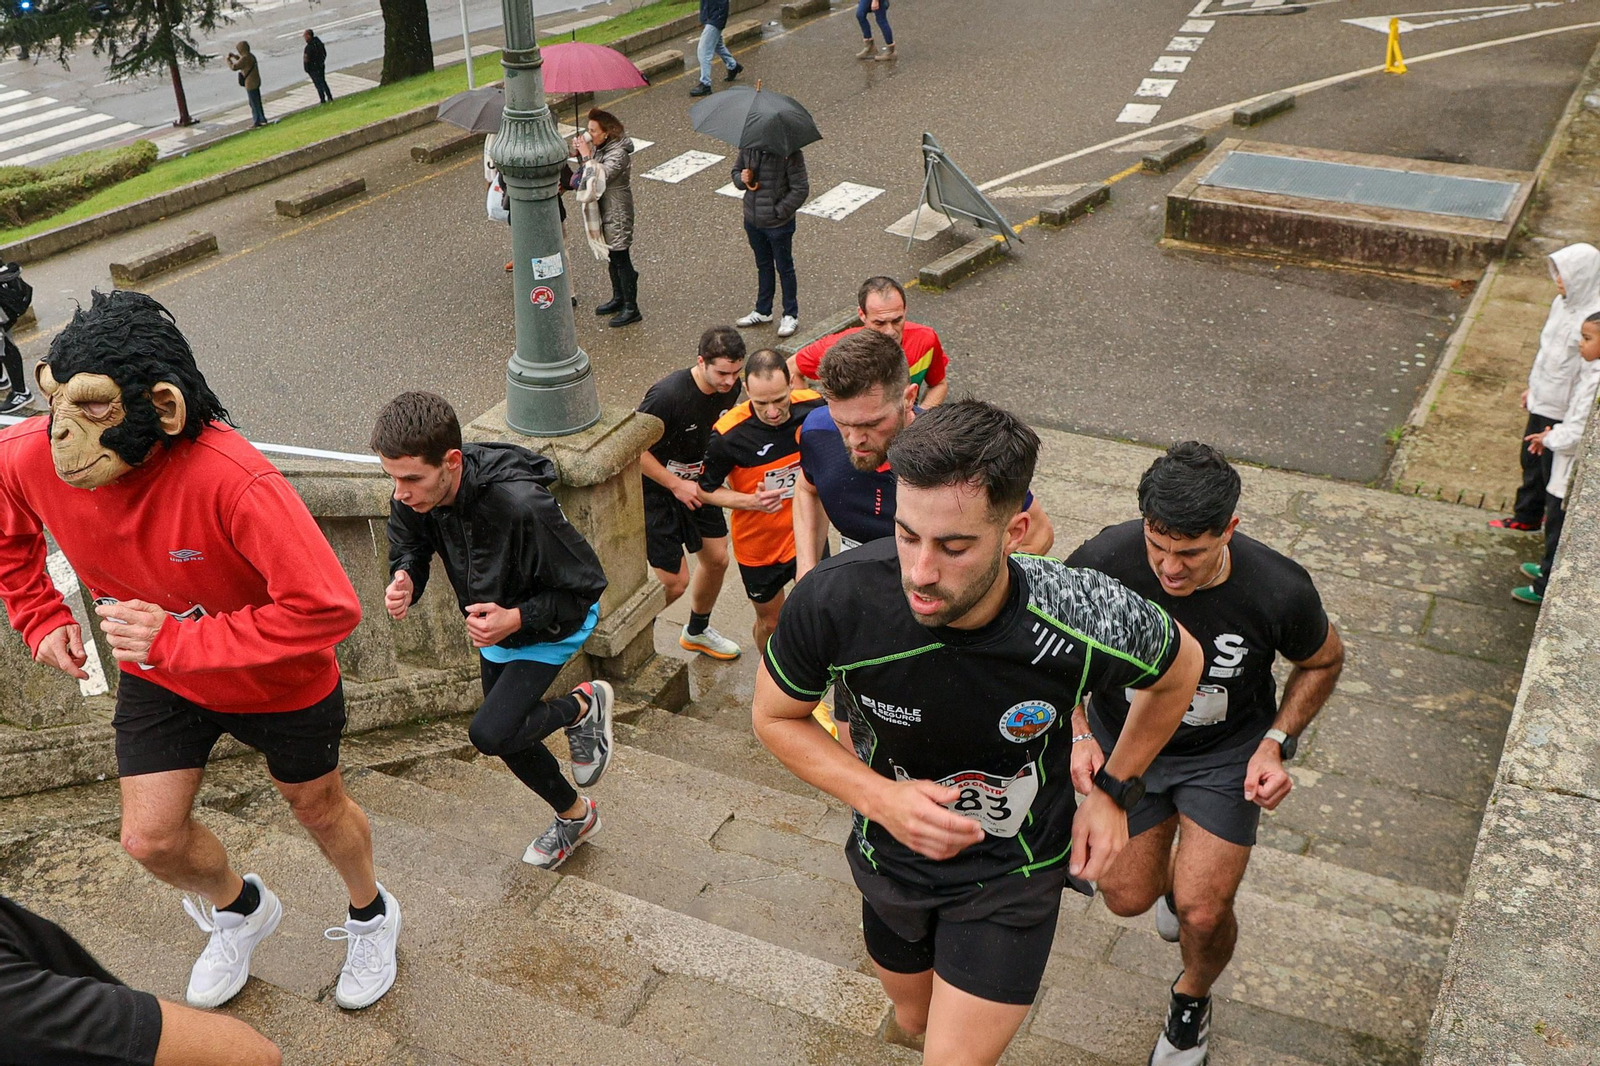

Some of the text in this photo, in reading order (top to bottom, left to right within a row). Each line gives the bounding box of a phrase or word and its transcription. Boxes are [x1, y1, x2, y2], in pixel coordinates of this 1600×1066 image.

[874, 488, 882, 515] KIPSTA
[877, 701, 922, 717] REALE
[878, 708, 922, 723] SEGUROS
[940, 788, 1012, 821] 83
